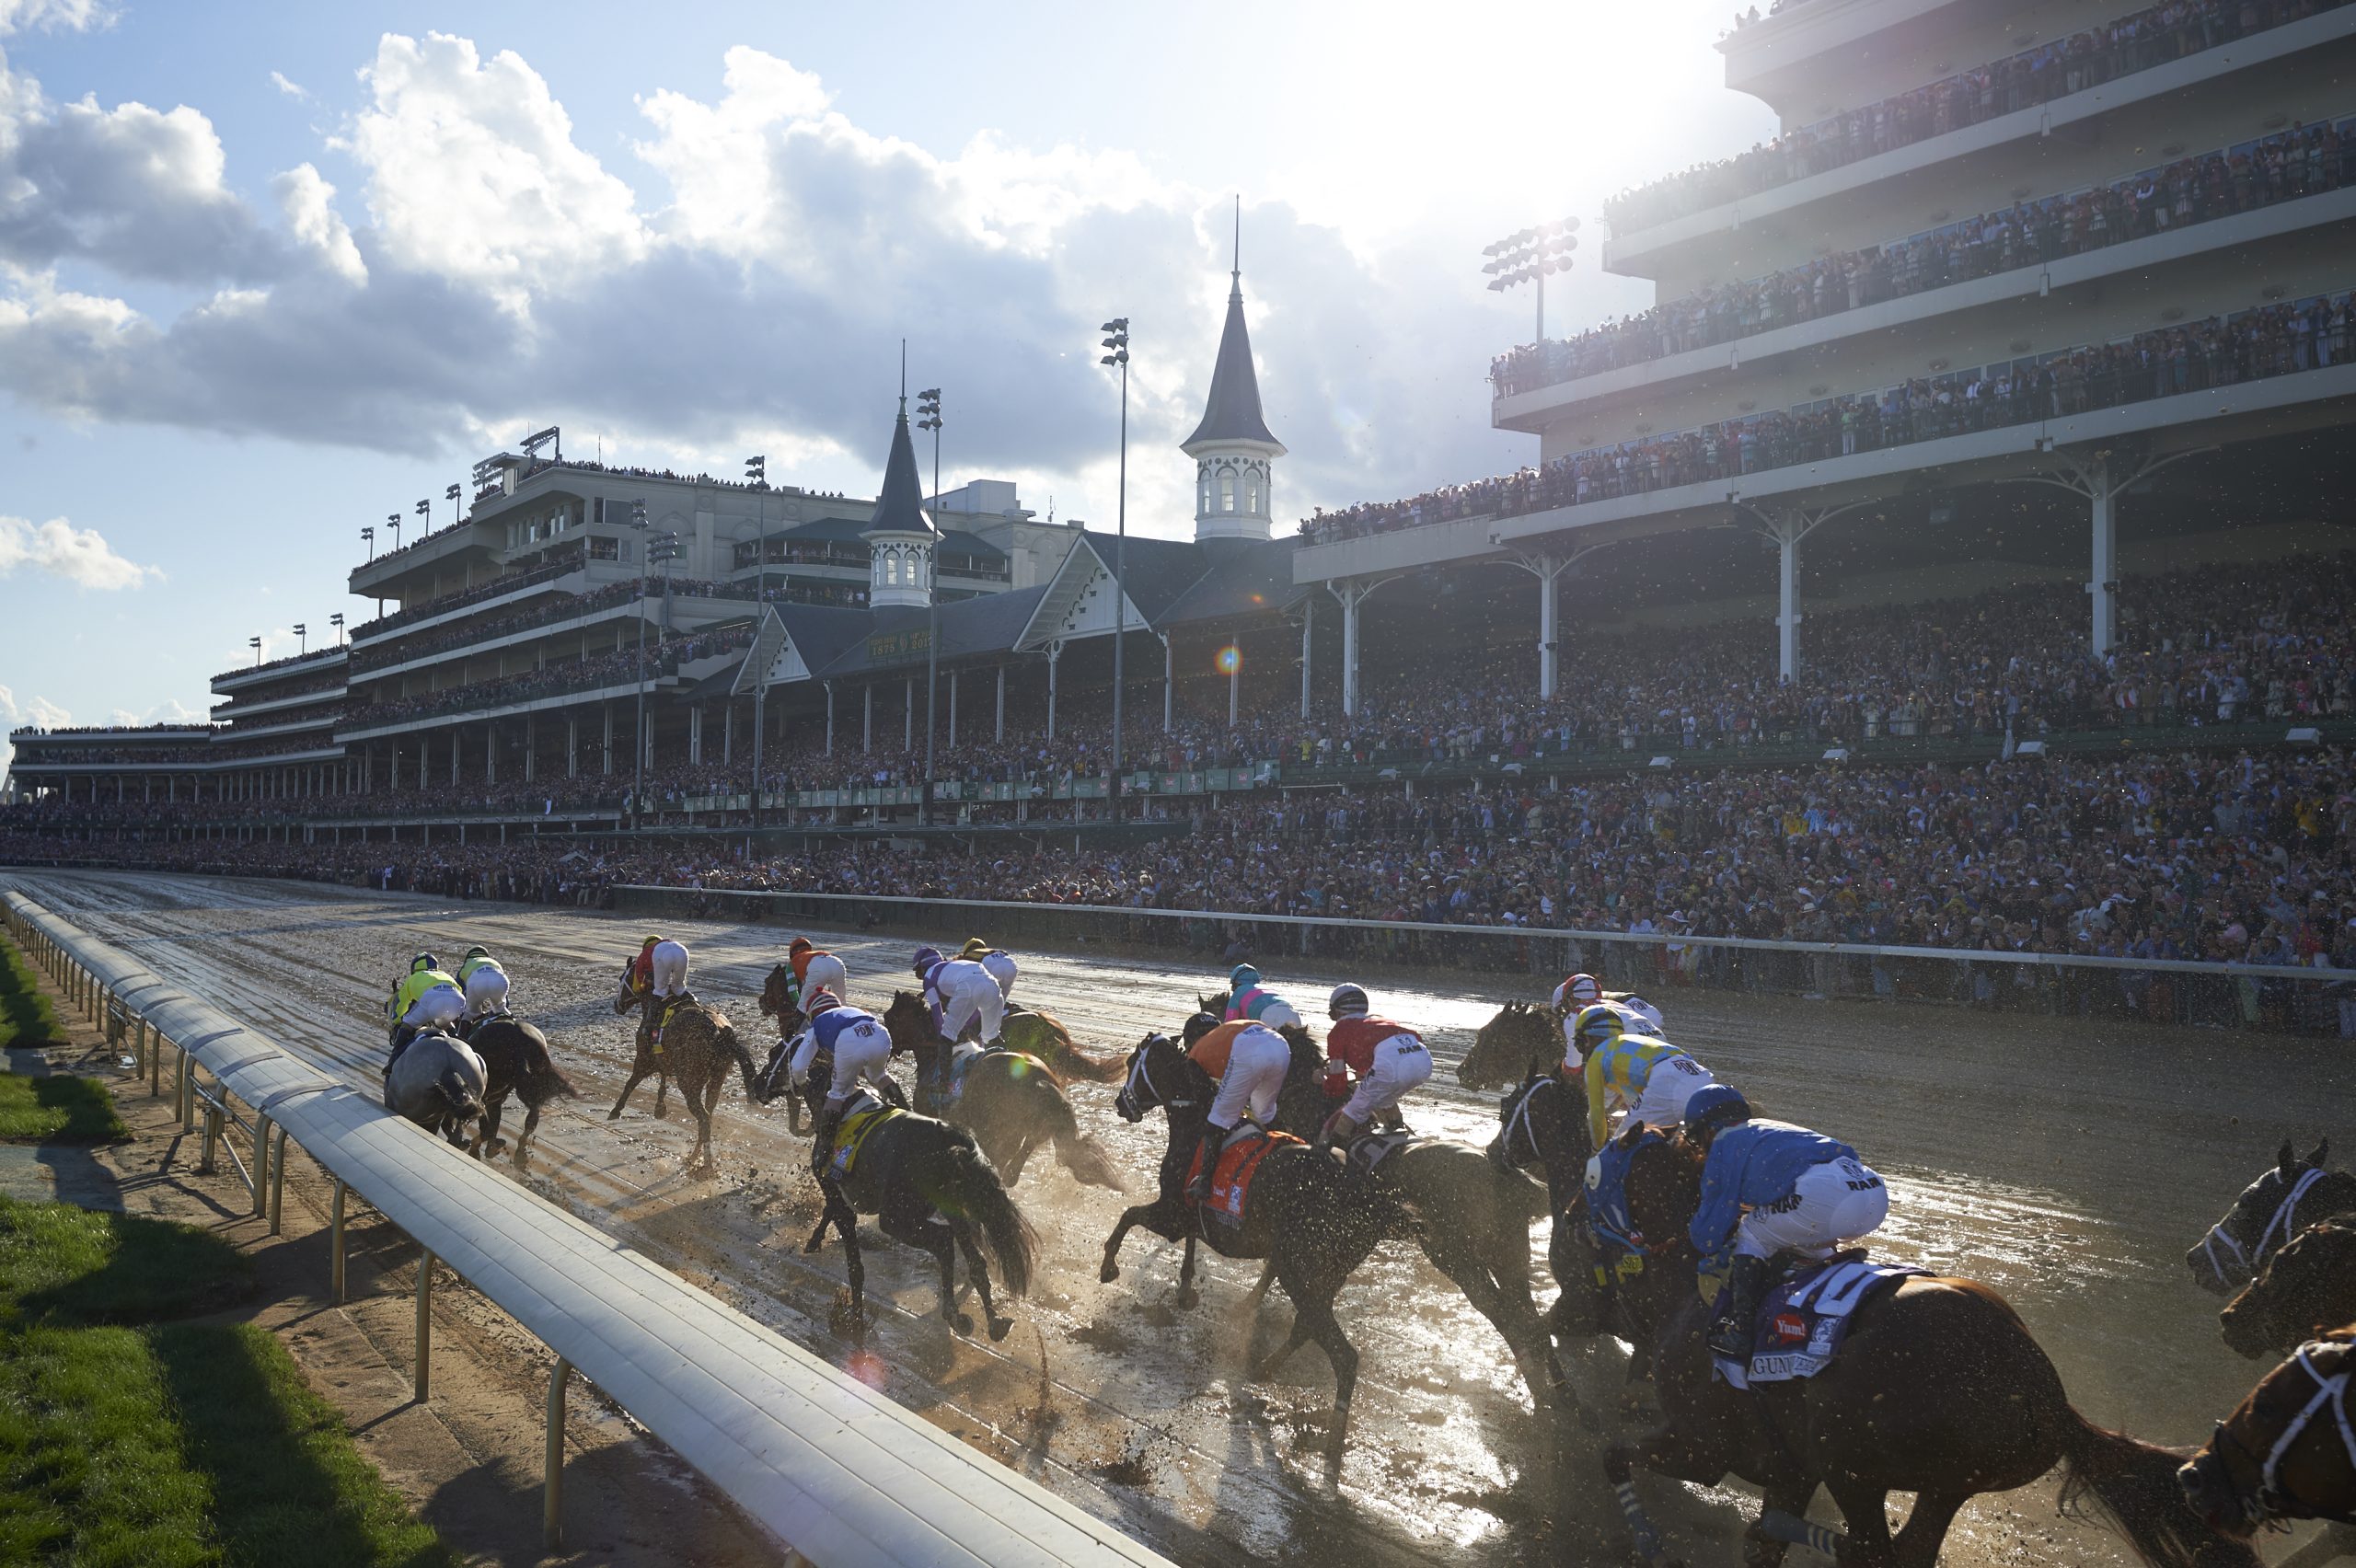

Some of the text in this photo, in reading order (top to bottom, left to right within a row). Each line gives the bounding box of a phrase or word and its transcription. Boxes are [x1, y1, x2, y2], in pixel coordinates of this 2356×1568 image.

[872, 644, 895, 656] 1875
[1397, 1044, 1424, 1055] RAM
[1845, 1177, 1883, 1192] RAM
[1776, 1319, 1807, 1337] Yum!
